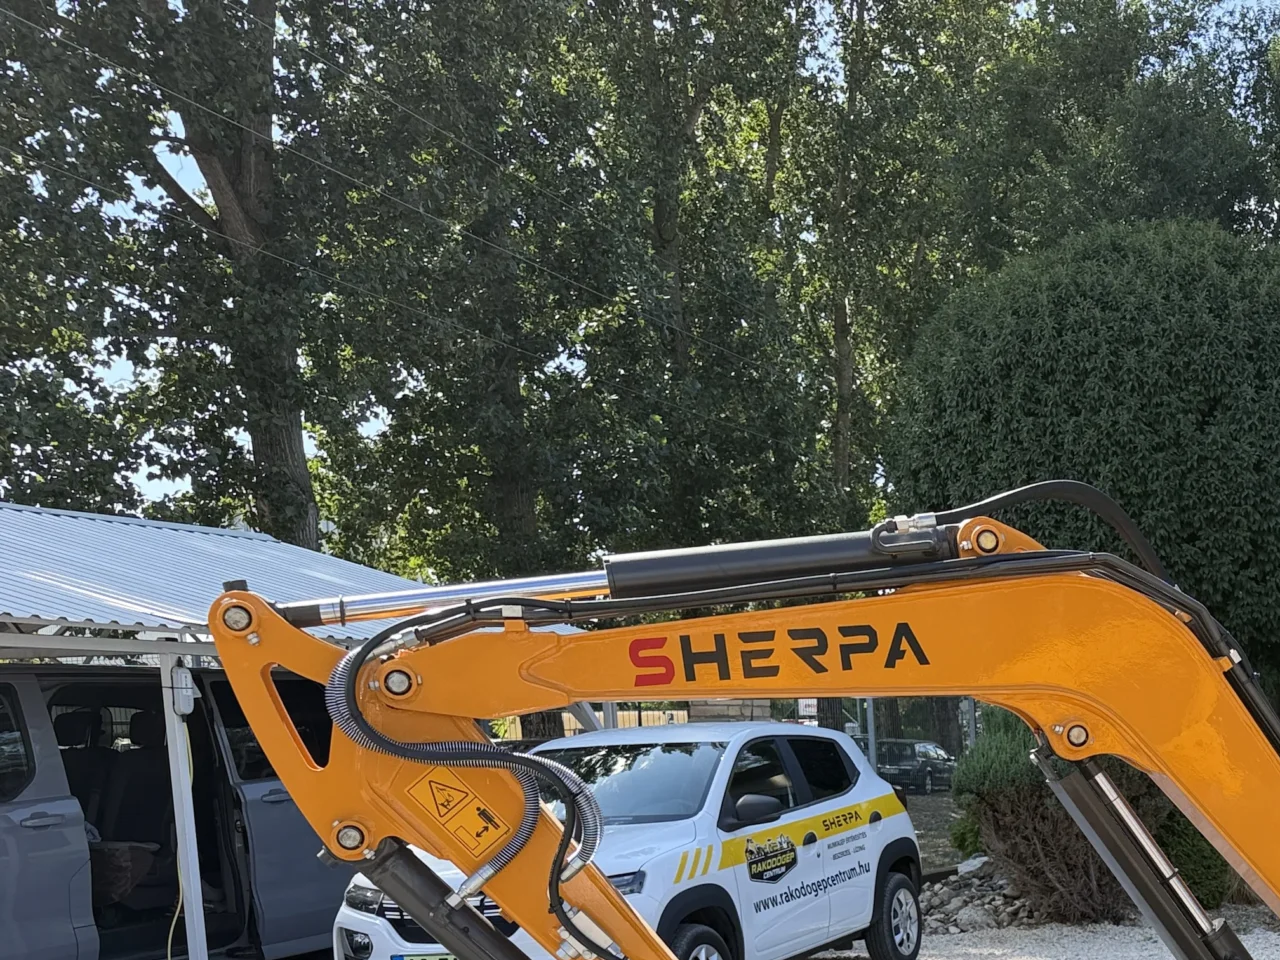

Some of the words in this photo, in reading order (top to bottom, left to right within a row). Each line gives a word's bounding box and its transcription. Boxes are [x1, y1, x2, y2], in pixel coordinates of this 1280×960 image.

[629, 622, 930, 687] SHERPA
[822, 810, 862, 831] SHERPA
[753, 860, 871, 913] www.rakodogepcentrum.hu
